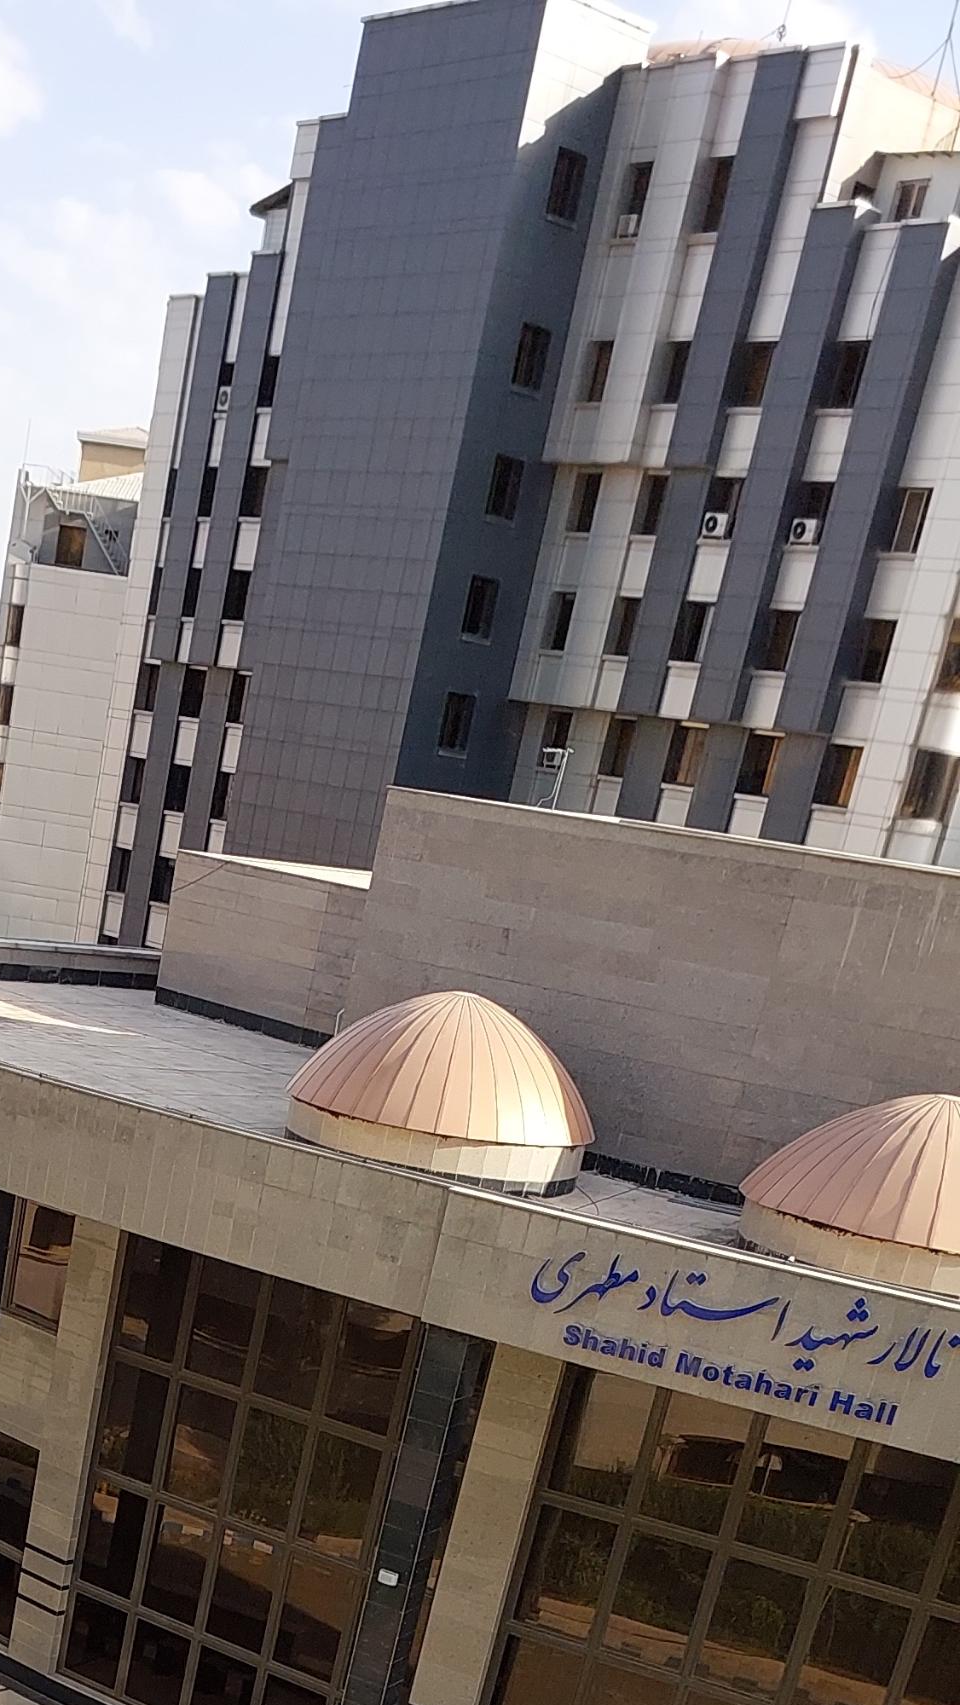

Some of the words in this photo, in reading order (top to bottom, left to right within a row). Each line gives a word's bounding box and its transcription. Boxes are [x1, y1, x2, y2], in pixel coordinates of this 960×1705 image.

[531, 1251, 640, 1314] مطهری
[637, 1269, 792, 1341] استاد
[784, 1297, 879, 1372] شهید
[562, 1323, 667, 1369] Shahid
[674, 1349, 820, 1407] Motahari
[828, 1390, 899, 1426] Hall
